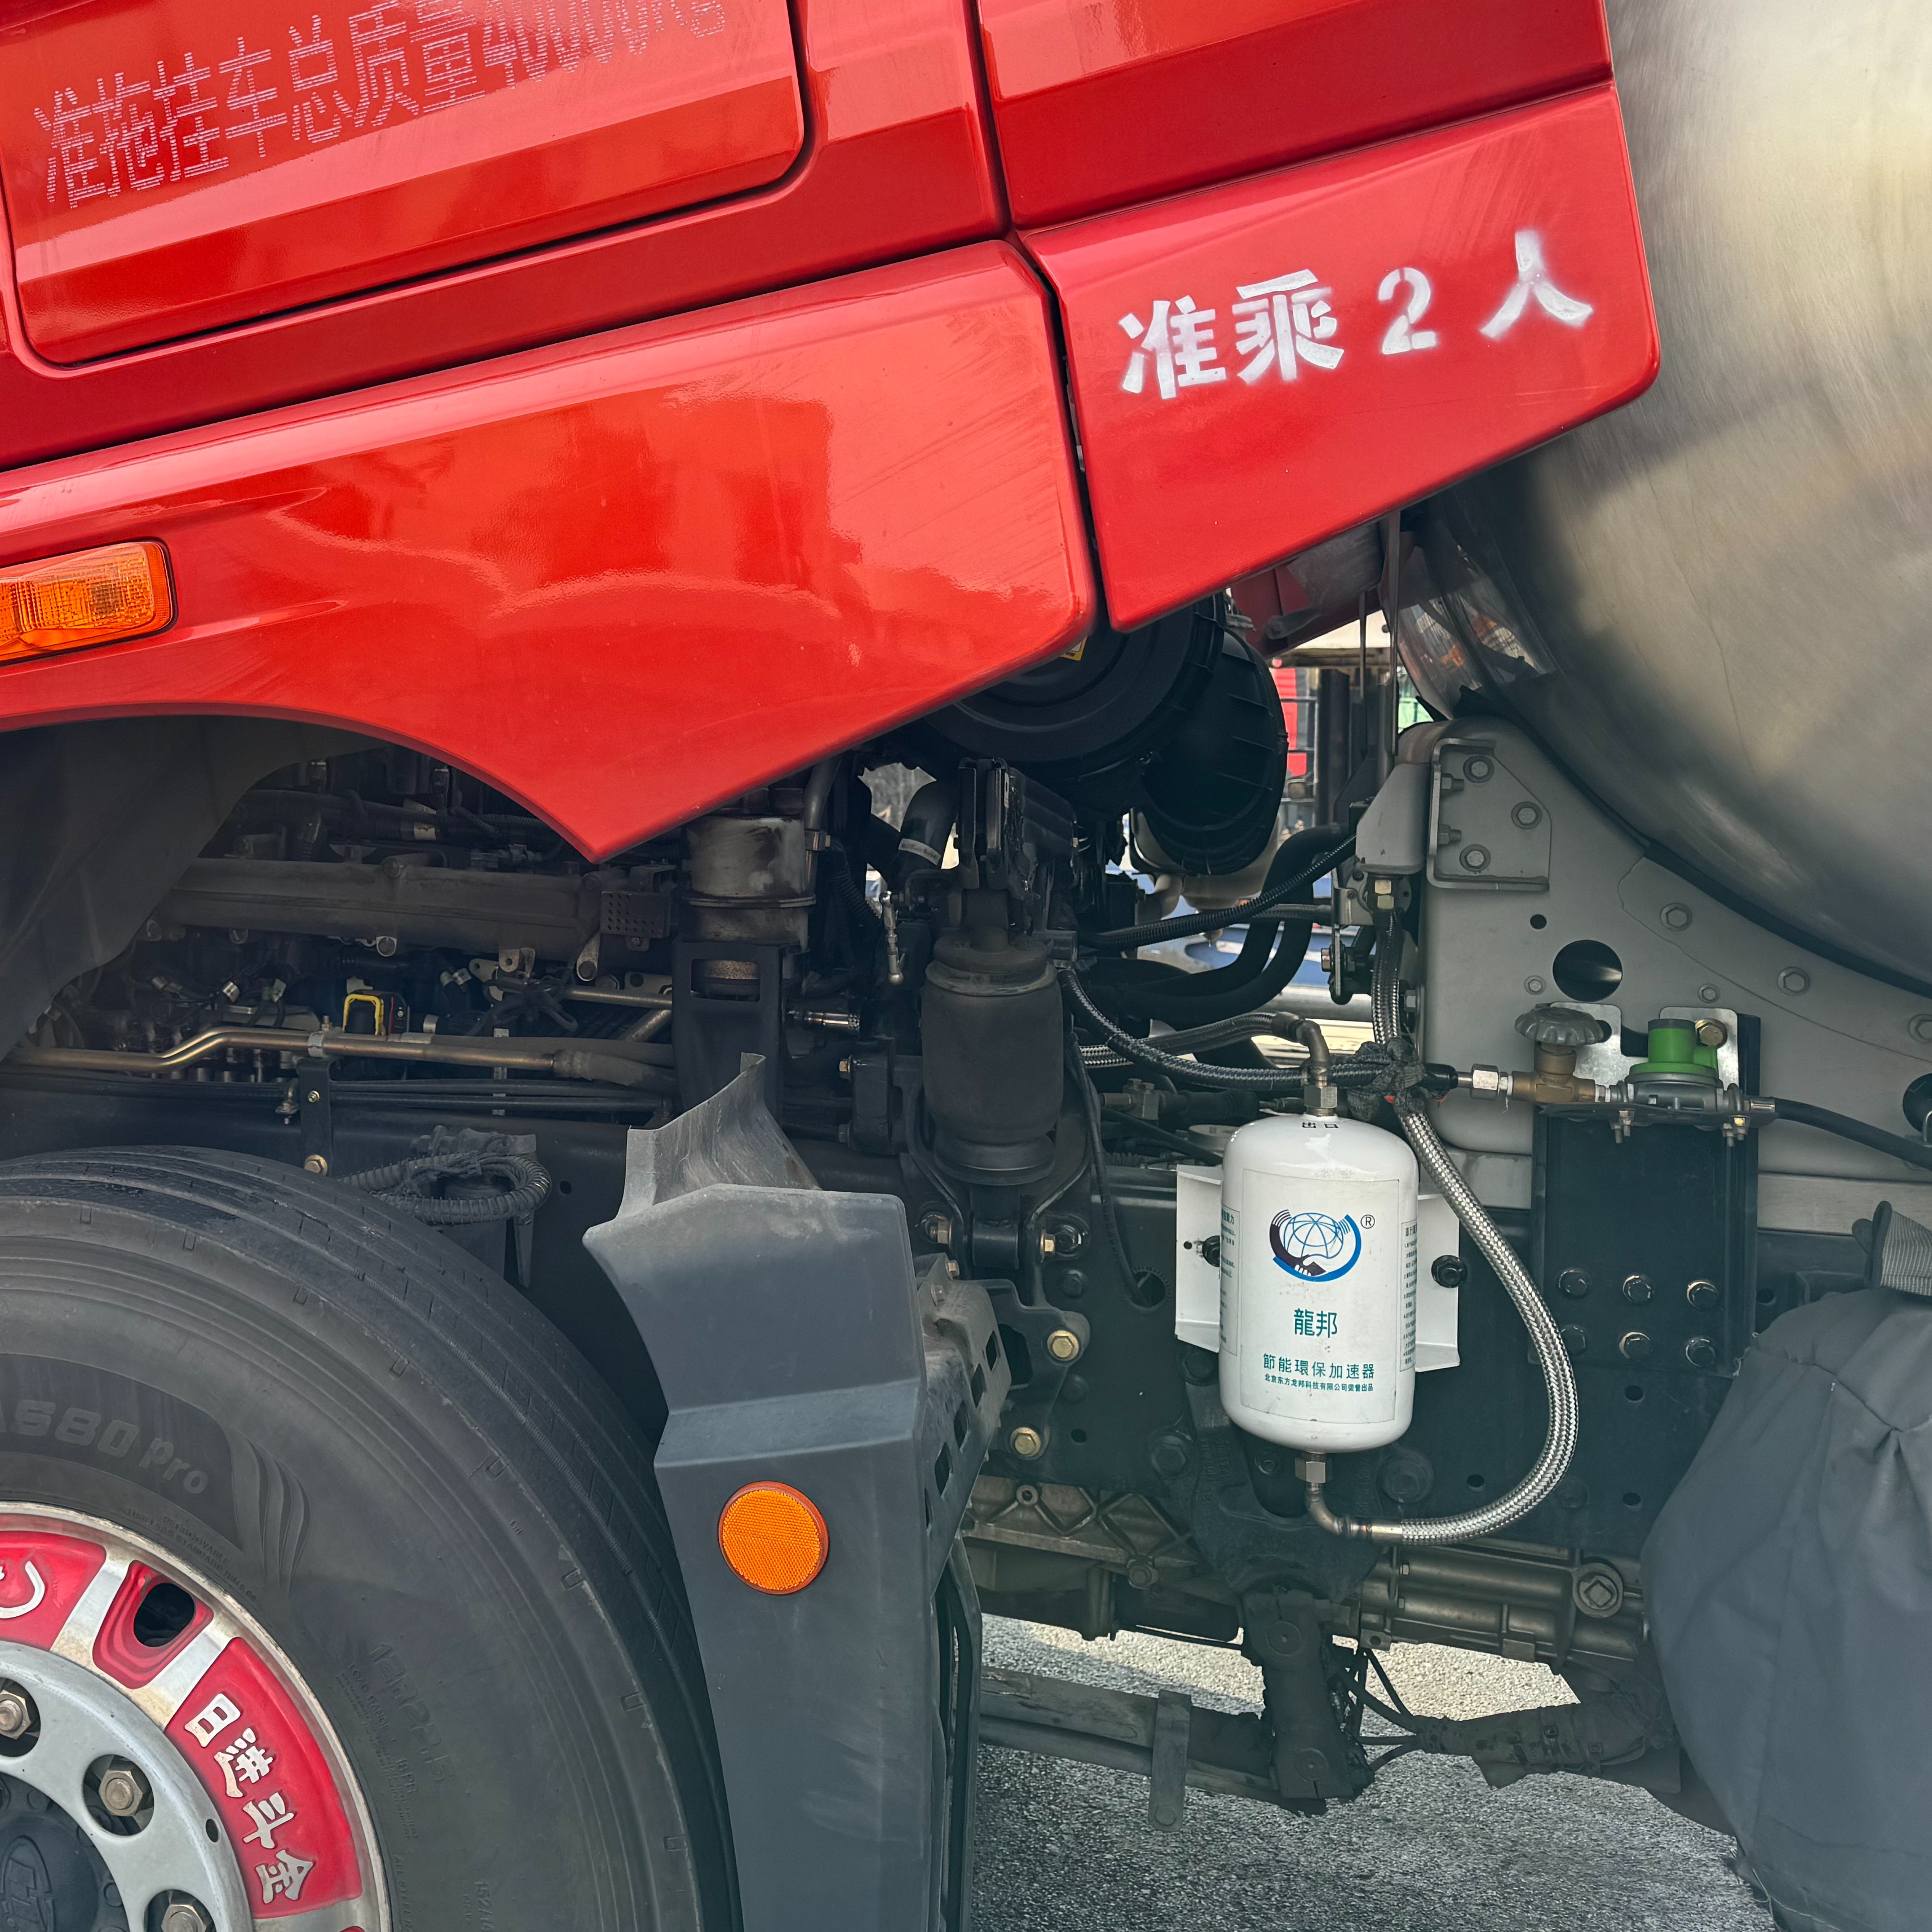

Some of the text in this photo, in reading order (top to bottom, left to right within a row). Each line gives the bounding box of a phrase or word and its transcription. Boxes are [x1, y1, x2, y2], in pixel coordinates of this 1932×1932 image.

[1294, 1308, 1338, 1338] 龍邦
[1263, 1352, 1374, 1380] 節能環保加速器
